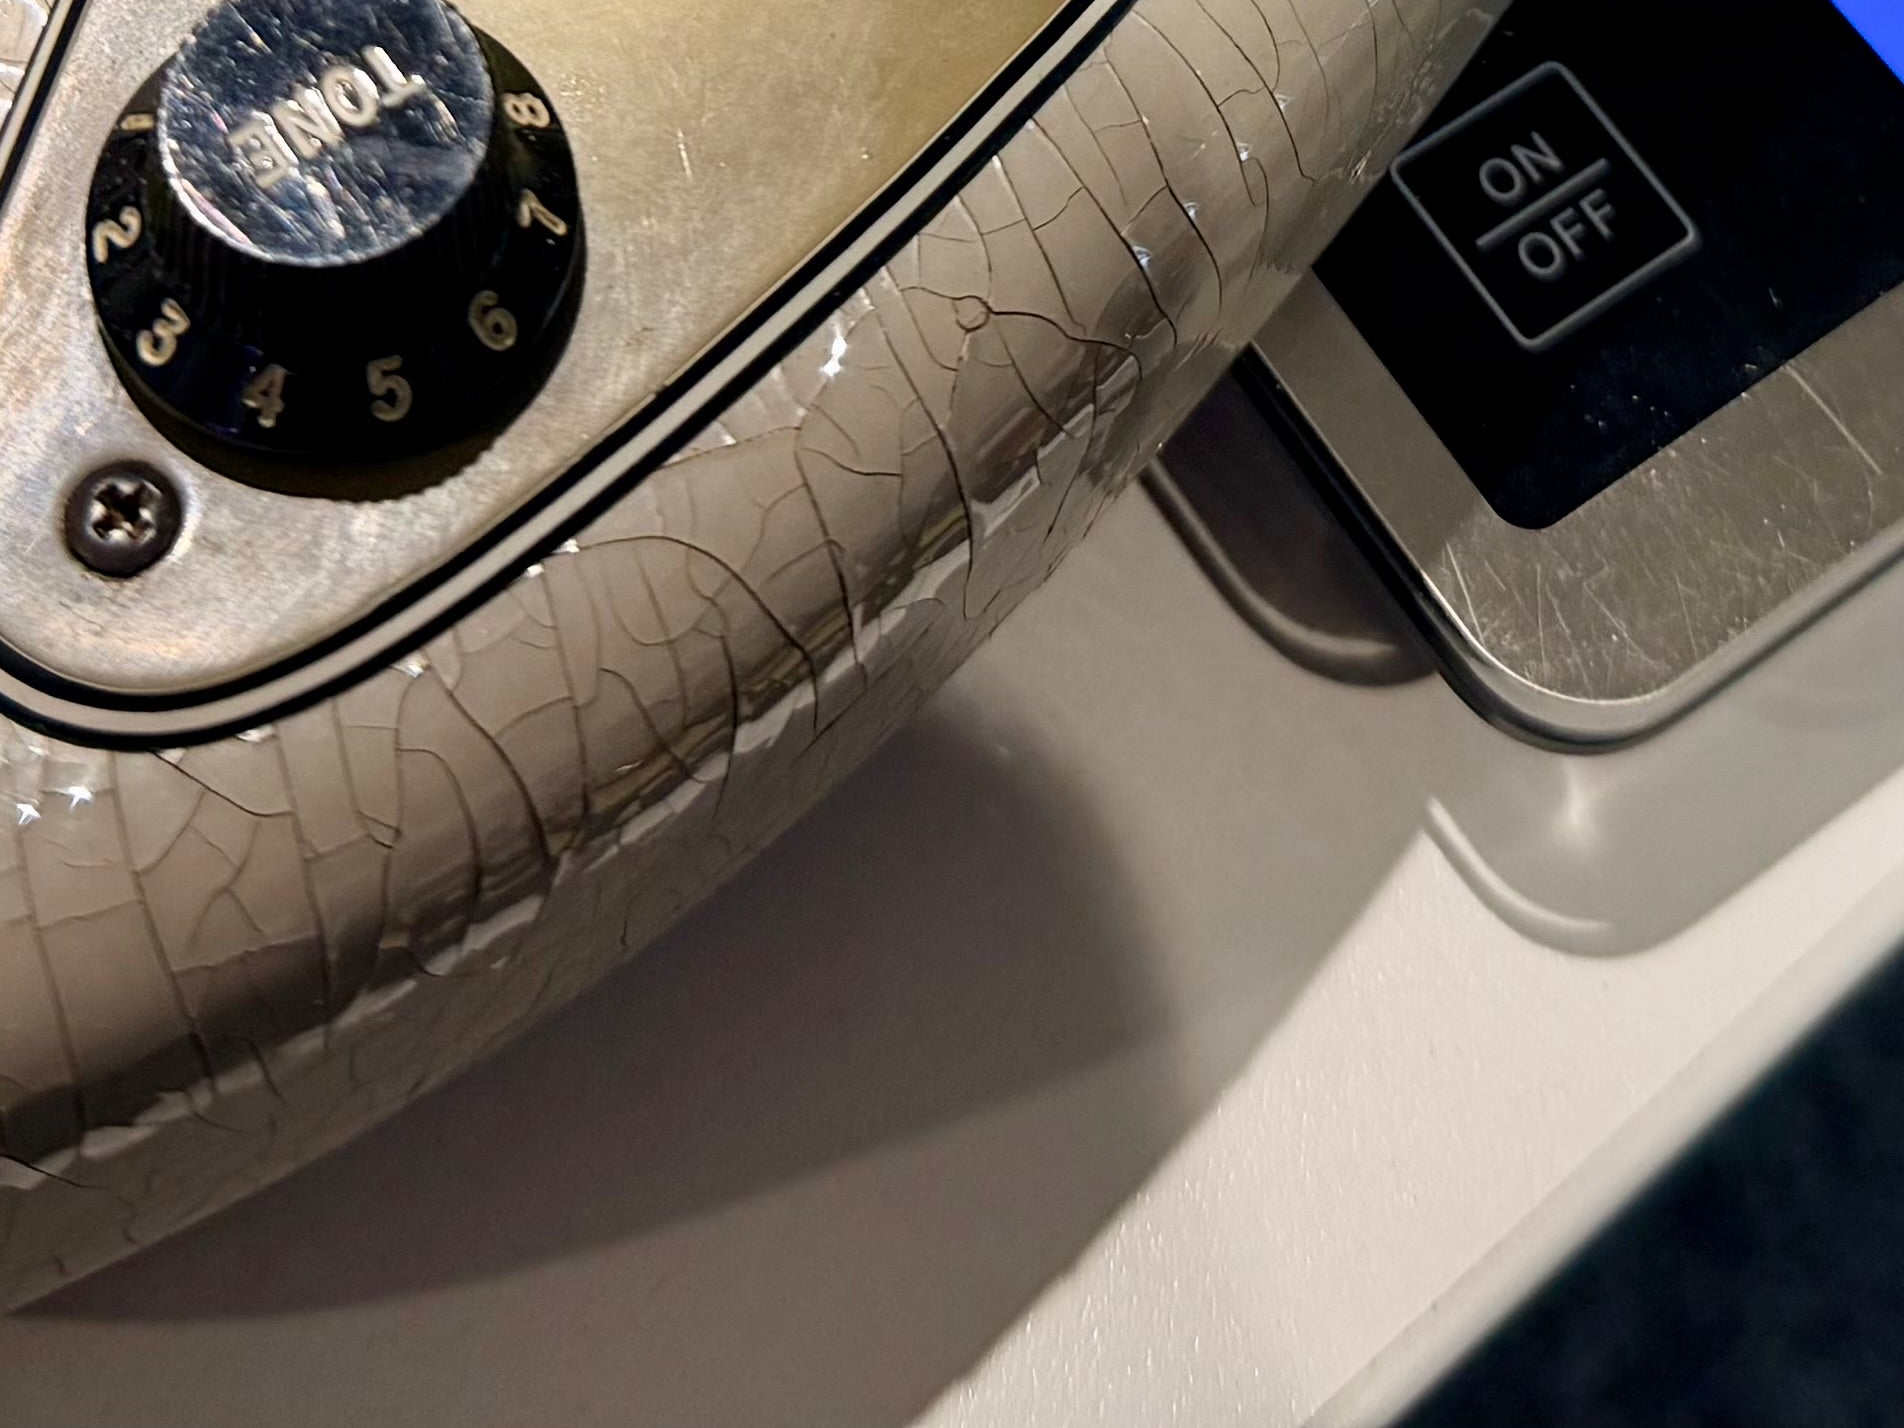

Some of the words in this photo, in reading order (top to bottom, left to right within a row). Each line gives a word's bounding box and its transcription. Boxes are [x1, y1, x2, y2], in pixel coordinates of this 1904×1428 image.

[227, 46, 430, 187] TONE
[501, 92, 551, 128] 8
[1478, 130, 1564, 204] ON
[93, 206, 143, 262] 2
[518, 188, 568, 236] 7
[1518, 188, 1616, 280] OFF
[137, 297, 190, 366] 3
[467, 290, 518, 351] 6
[243, 363, 288, 429] 4
[365, 355, 413, 422] 5
